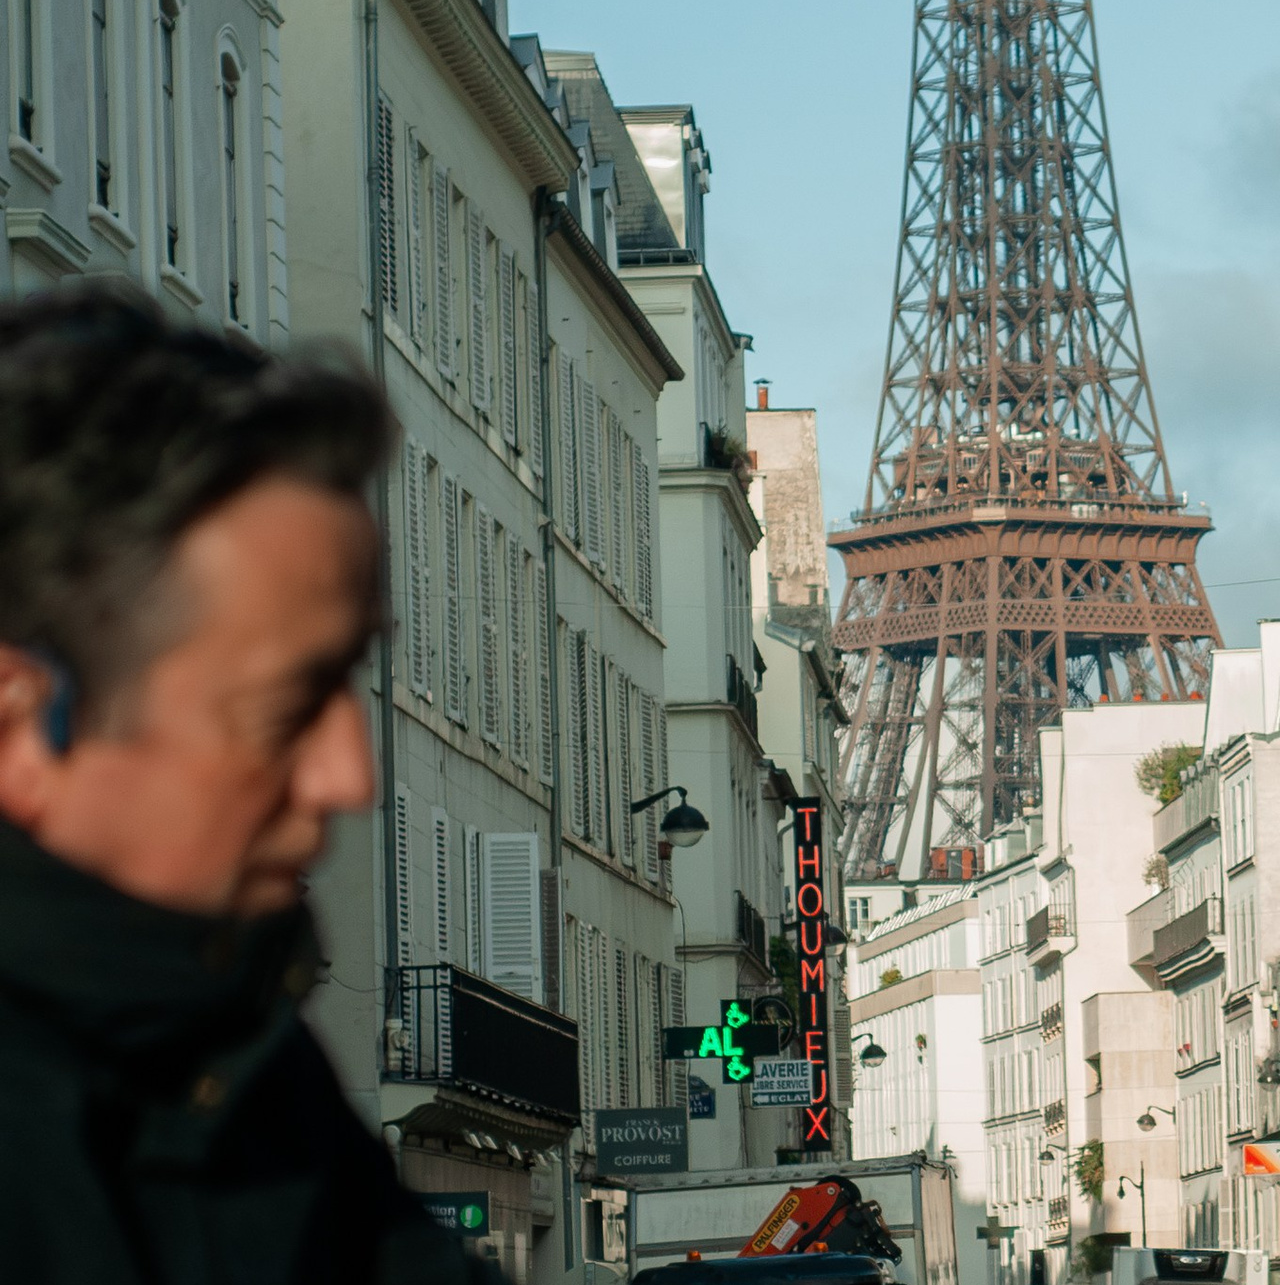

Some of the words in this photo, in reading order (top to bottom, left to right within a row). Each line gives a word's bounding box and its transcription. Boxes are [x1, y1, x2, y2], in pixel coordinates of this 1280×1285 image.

[698, 1026, 745, 1057] AL
[753, 1062, 809, 1079] AVERIE
[776, 1078, 809, 1090] SERVICE
[601, 1125, 684, 1143] PROVOST
[614, 1154, 671, 1167] COIFFURE
[753, 1197, 798, 1249] PALFINGER
